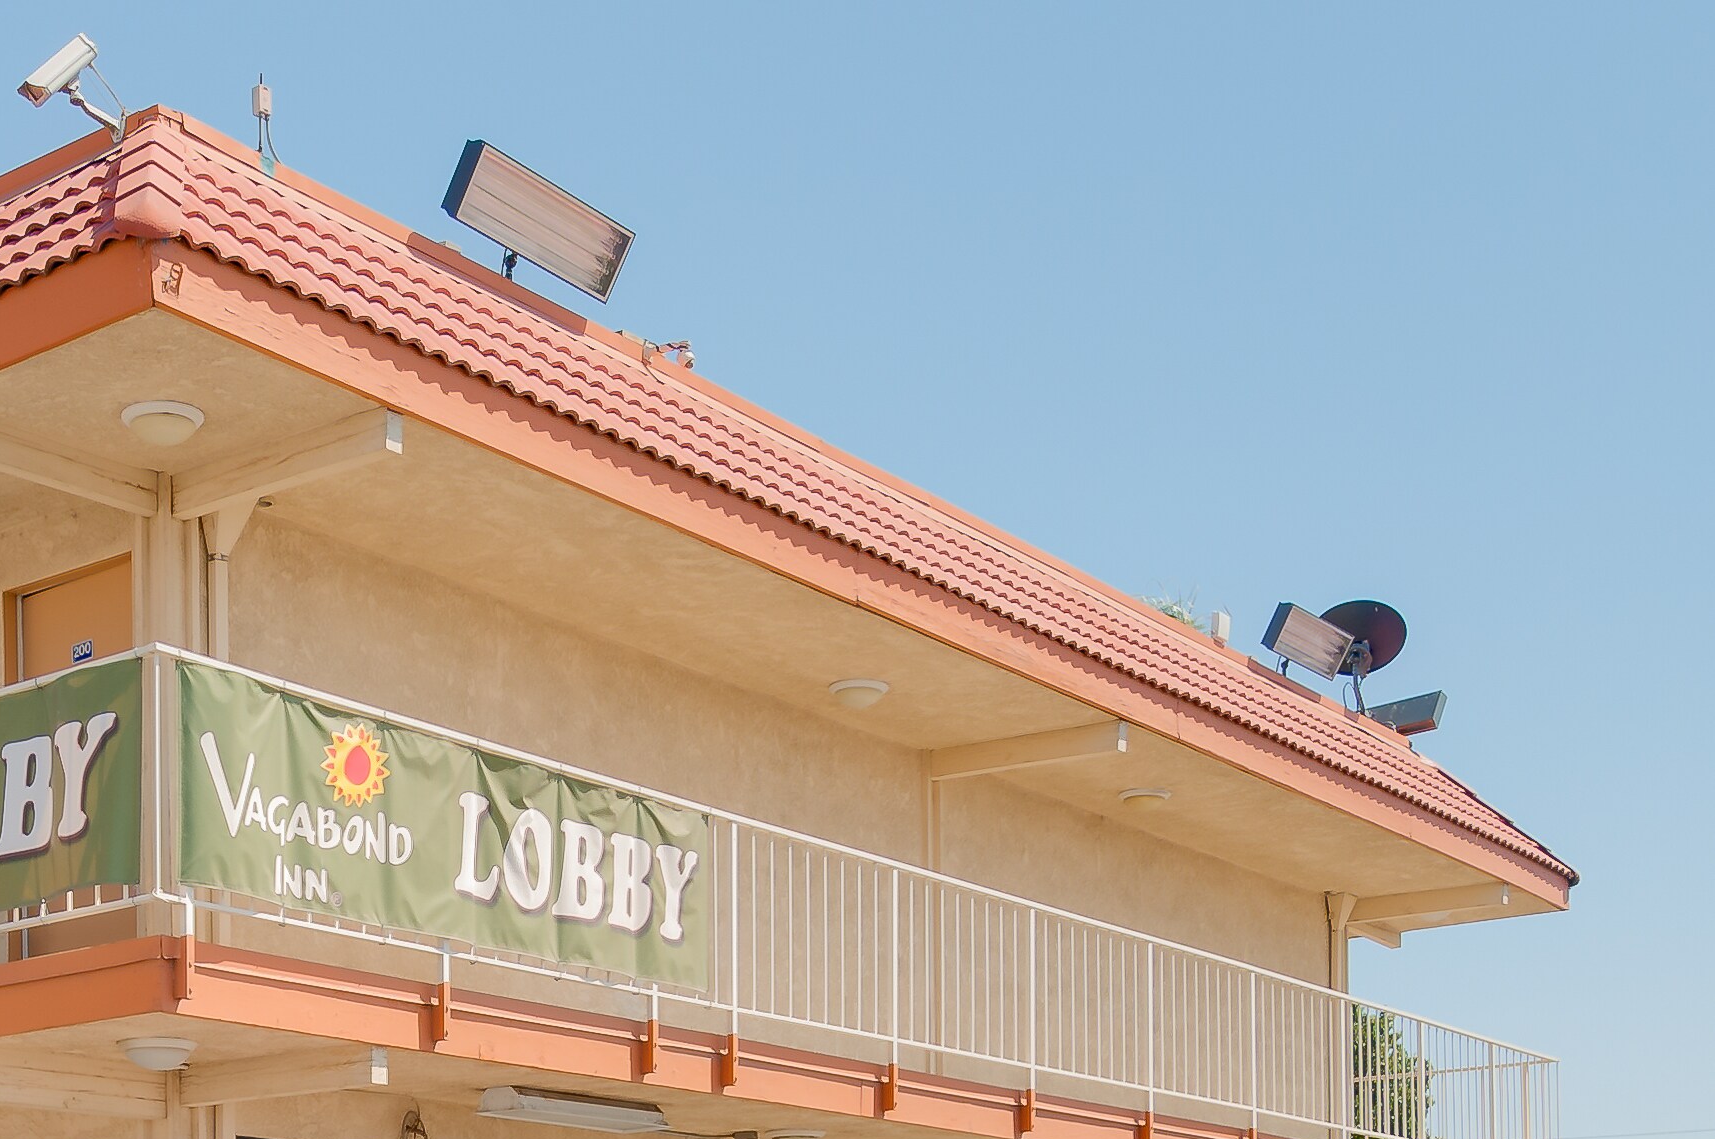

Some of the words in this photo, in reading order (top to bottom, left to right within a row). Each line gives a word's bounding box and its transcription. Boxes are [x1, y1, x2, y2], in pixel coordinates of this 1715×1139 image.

[73, 642, 91, 659] 200
[200, 731, 413, 865] VAGABOND
[274, 854, 329, 904] INN
[454, 791, 700, 943] LOBBY
